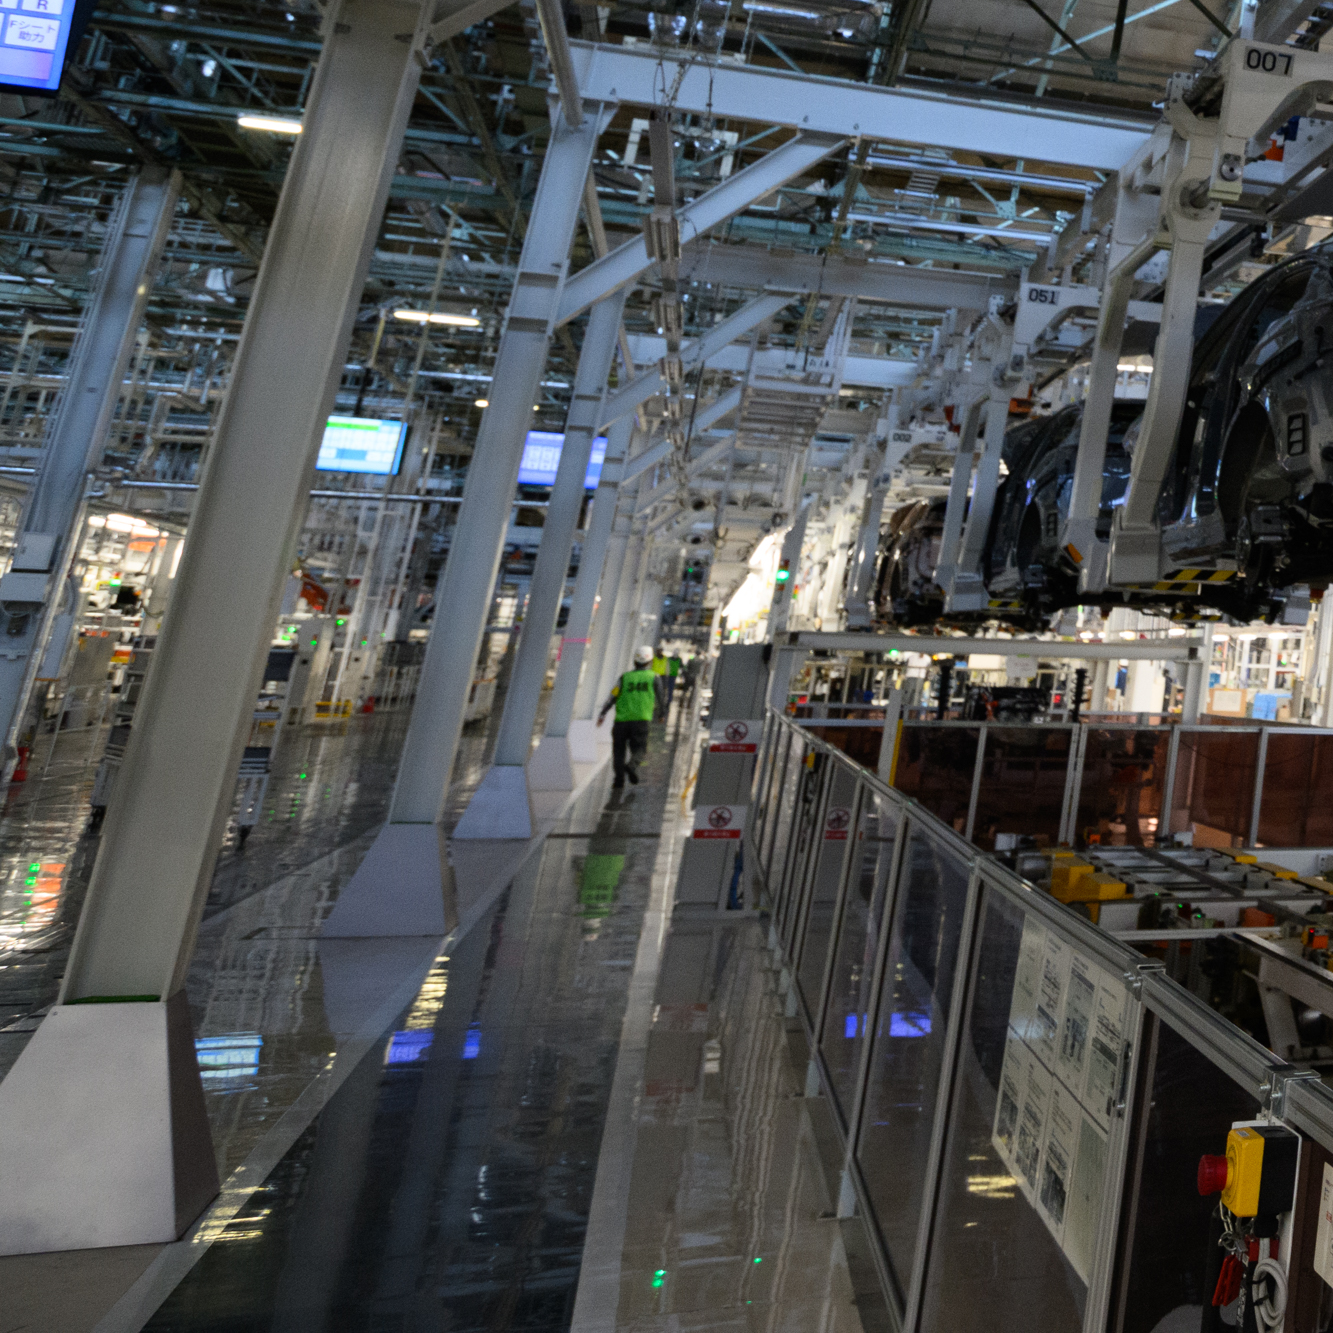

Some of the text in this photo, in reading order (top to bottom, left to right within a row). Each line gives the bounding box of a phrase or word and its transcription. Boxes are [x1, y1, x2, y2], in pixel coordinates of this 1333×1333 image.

[37, 0, 48, 11] R
[10, 20, 56, 34] Fシート
[1246, 49, 1293, 75] 007
[1028, 288, 1056, 305] 051
